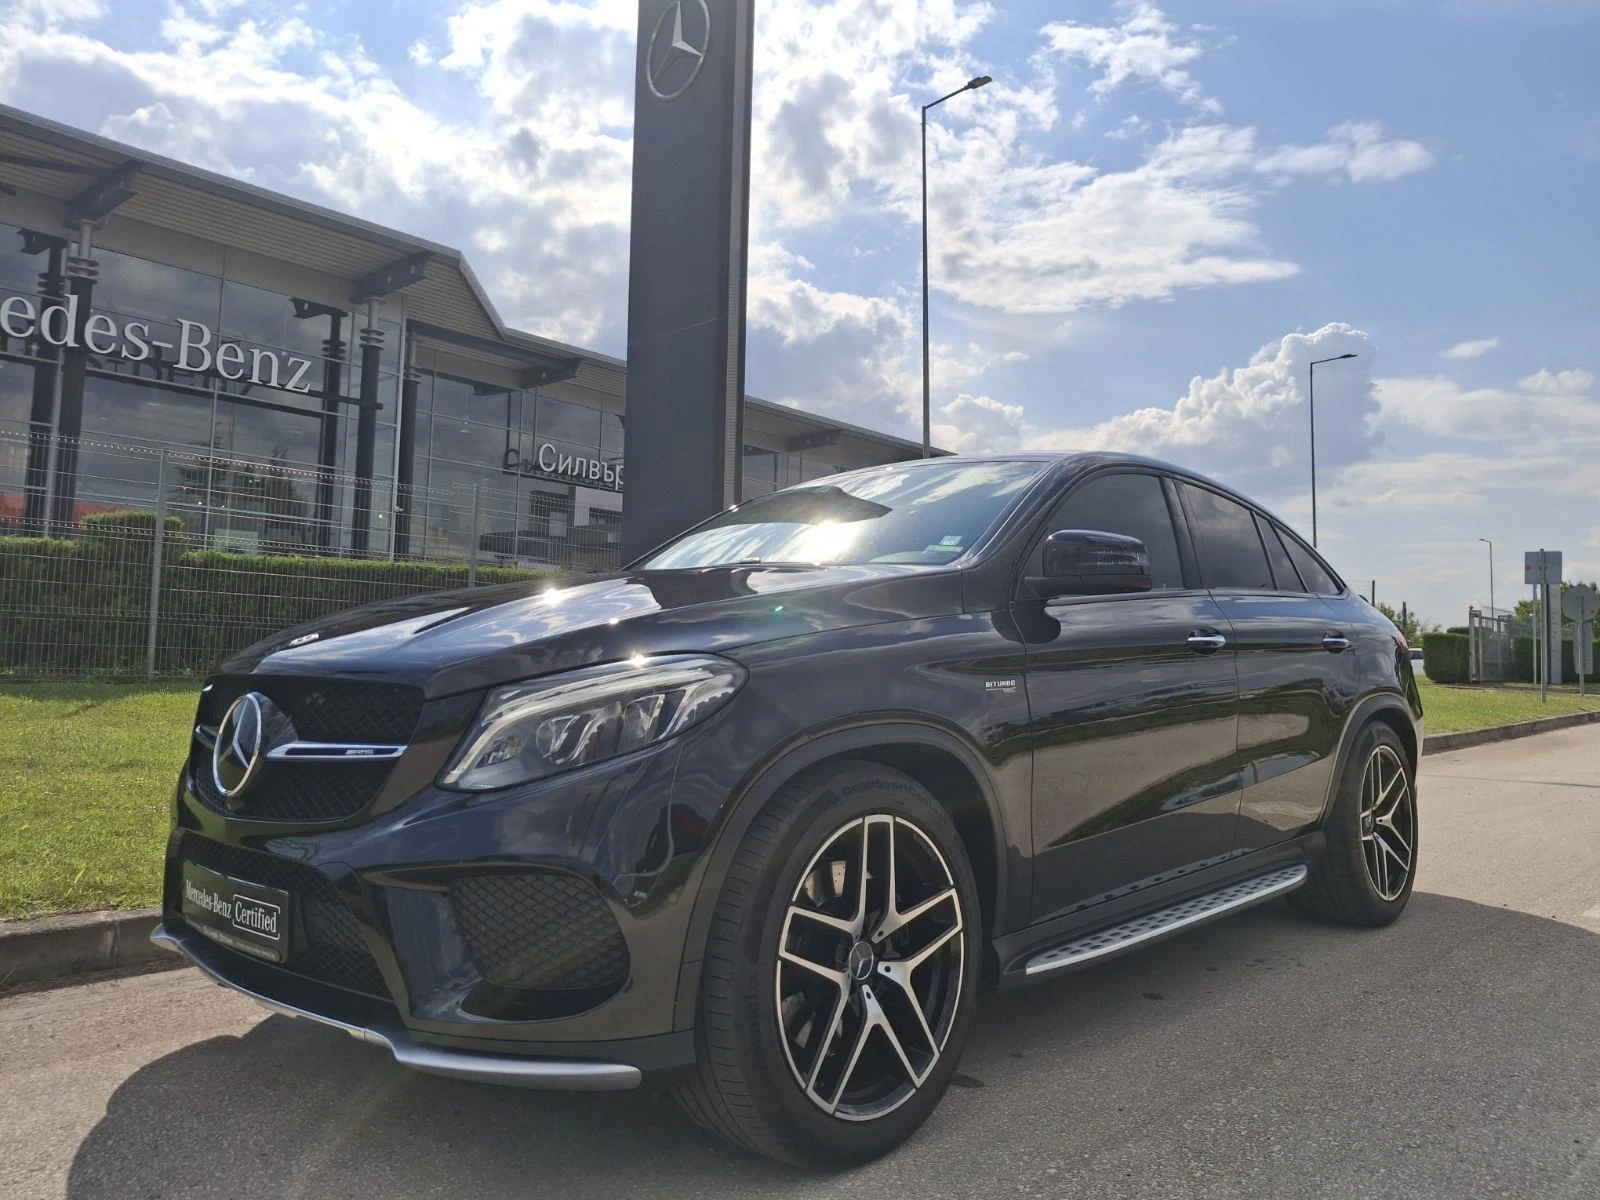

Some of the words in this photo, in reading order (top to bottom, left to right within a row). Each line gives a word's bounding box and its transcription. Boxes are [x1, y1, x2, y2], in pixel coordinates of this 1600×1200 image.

[0, 294, 313, 394] edes-Benz
[185, 879, 232, 919] Mercedes-Benz
[235, 901, 277, 933] Certified
